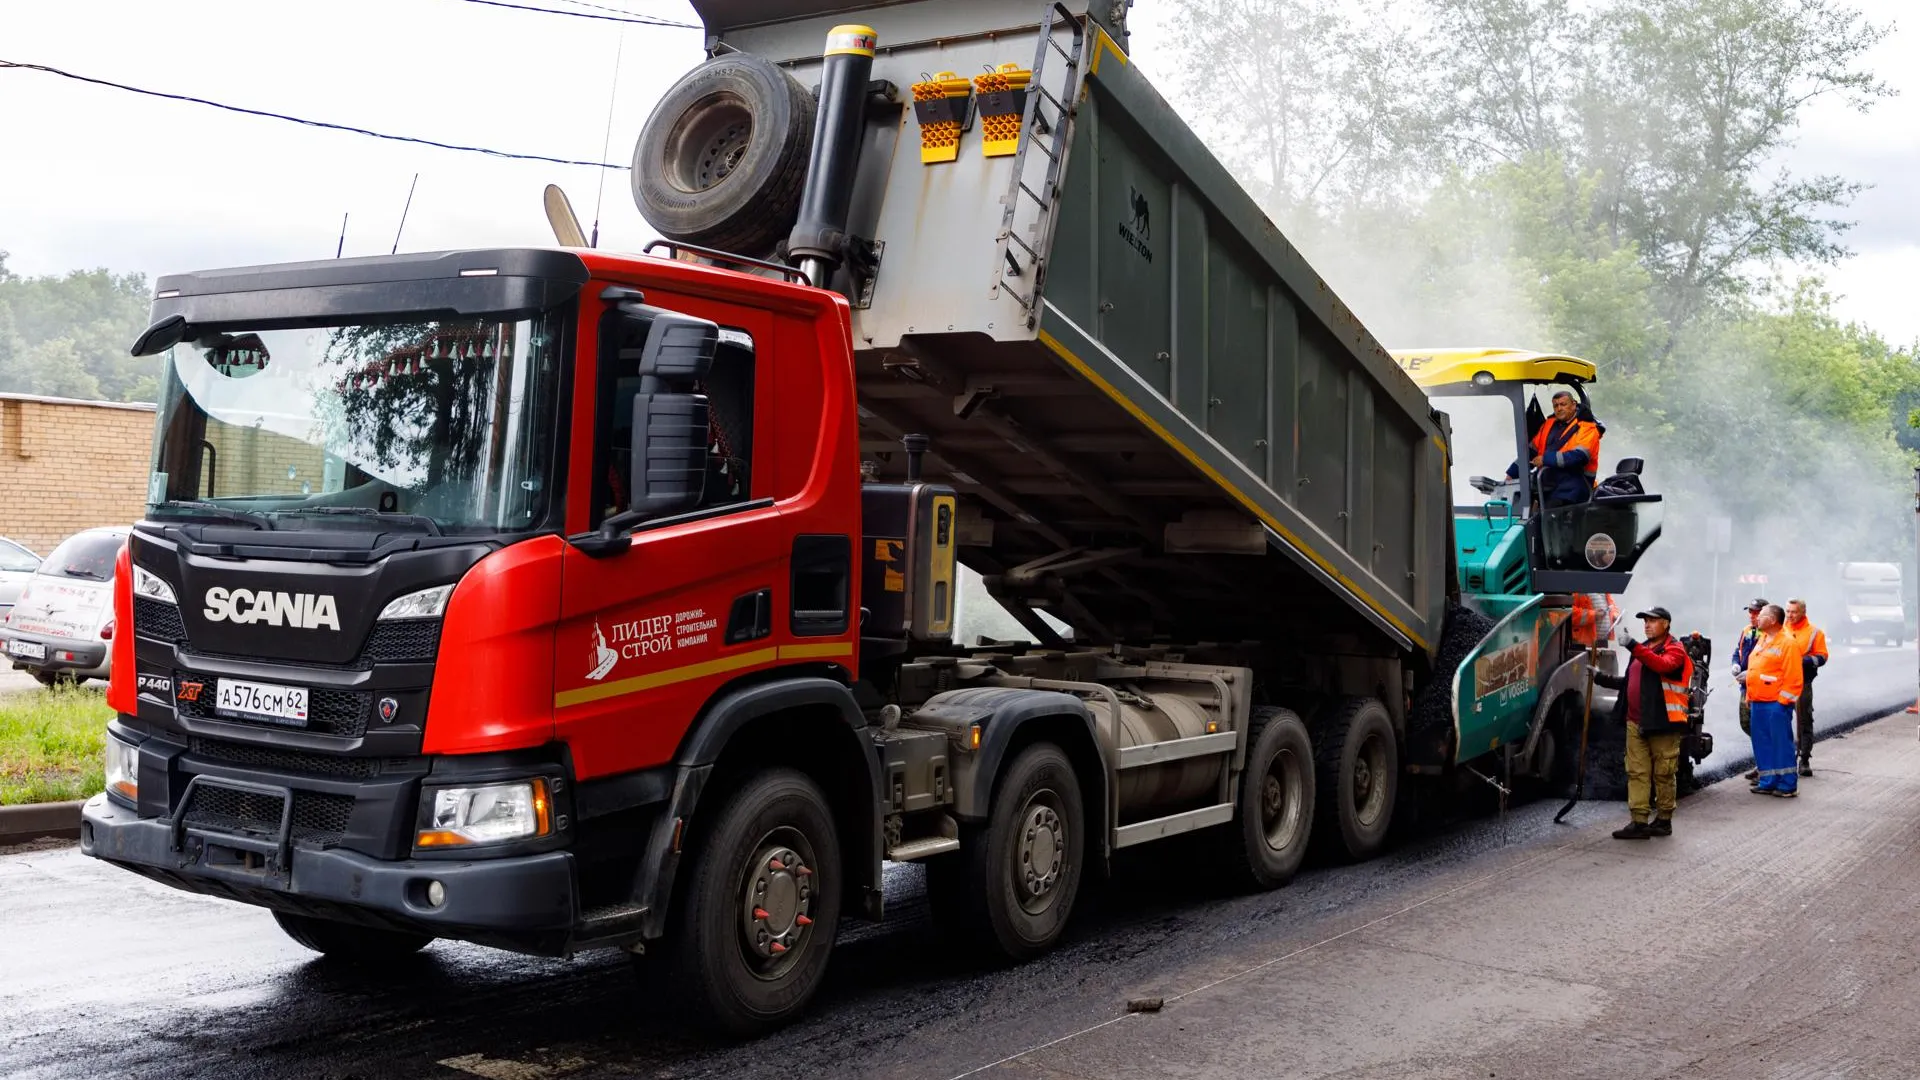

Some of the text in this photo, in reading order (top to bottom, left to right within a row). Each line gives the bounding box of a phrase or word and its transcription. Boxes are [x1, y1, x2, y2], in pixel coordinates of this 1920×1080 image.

[1119, 222, 1153, 264] WIELTON
[203, 586, 341, 631] SCANIA
[675, 608, 706, 624] ДОРОЖНО-
[611, 615, 672, 643] ЛИДЕР
[676, 618, 718, 636] СТРОИТЕЛЬНАЯ
[621, 634, 673, 660] СТРОЙ
[677, 633, 708, 649] КОМПАНИЯ
[177, 681, 203, 701] XT
[286, 690, 303, 709] 62
